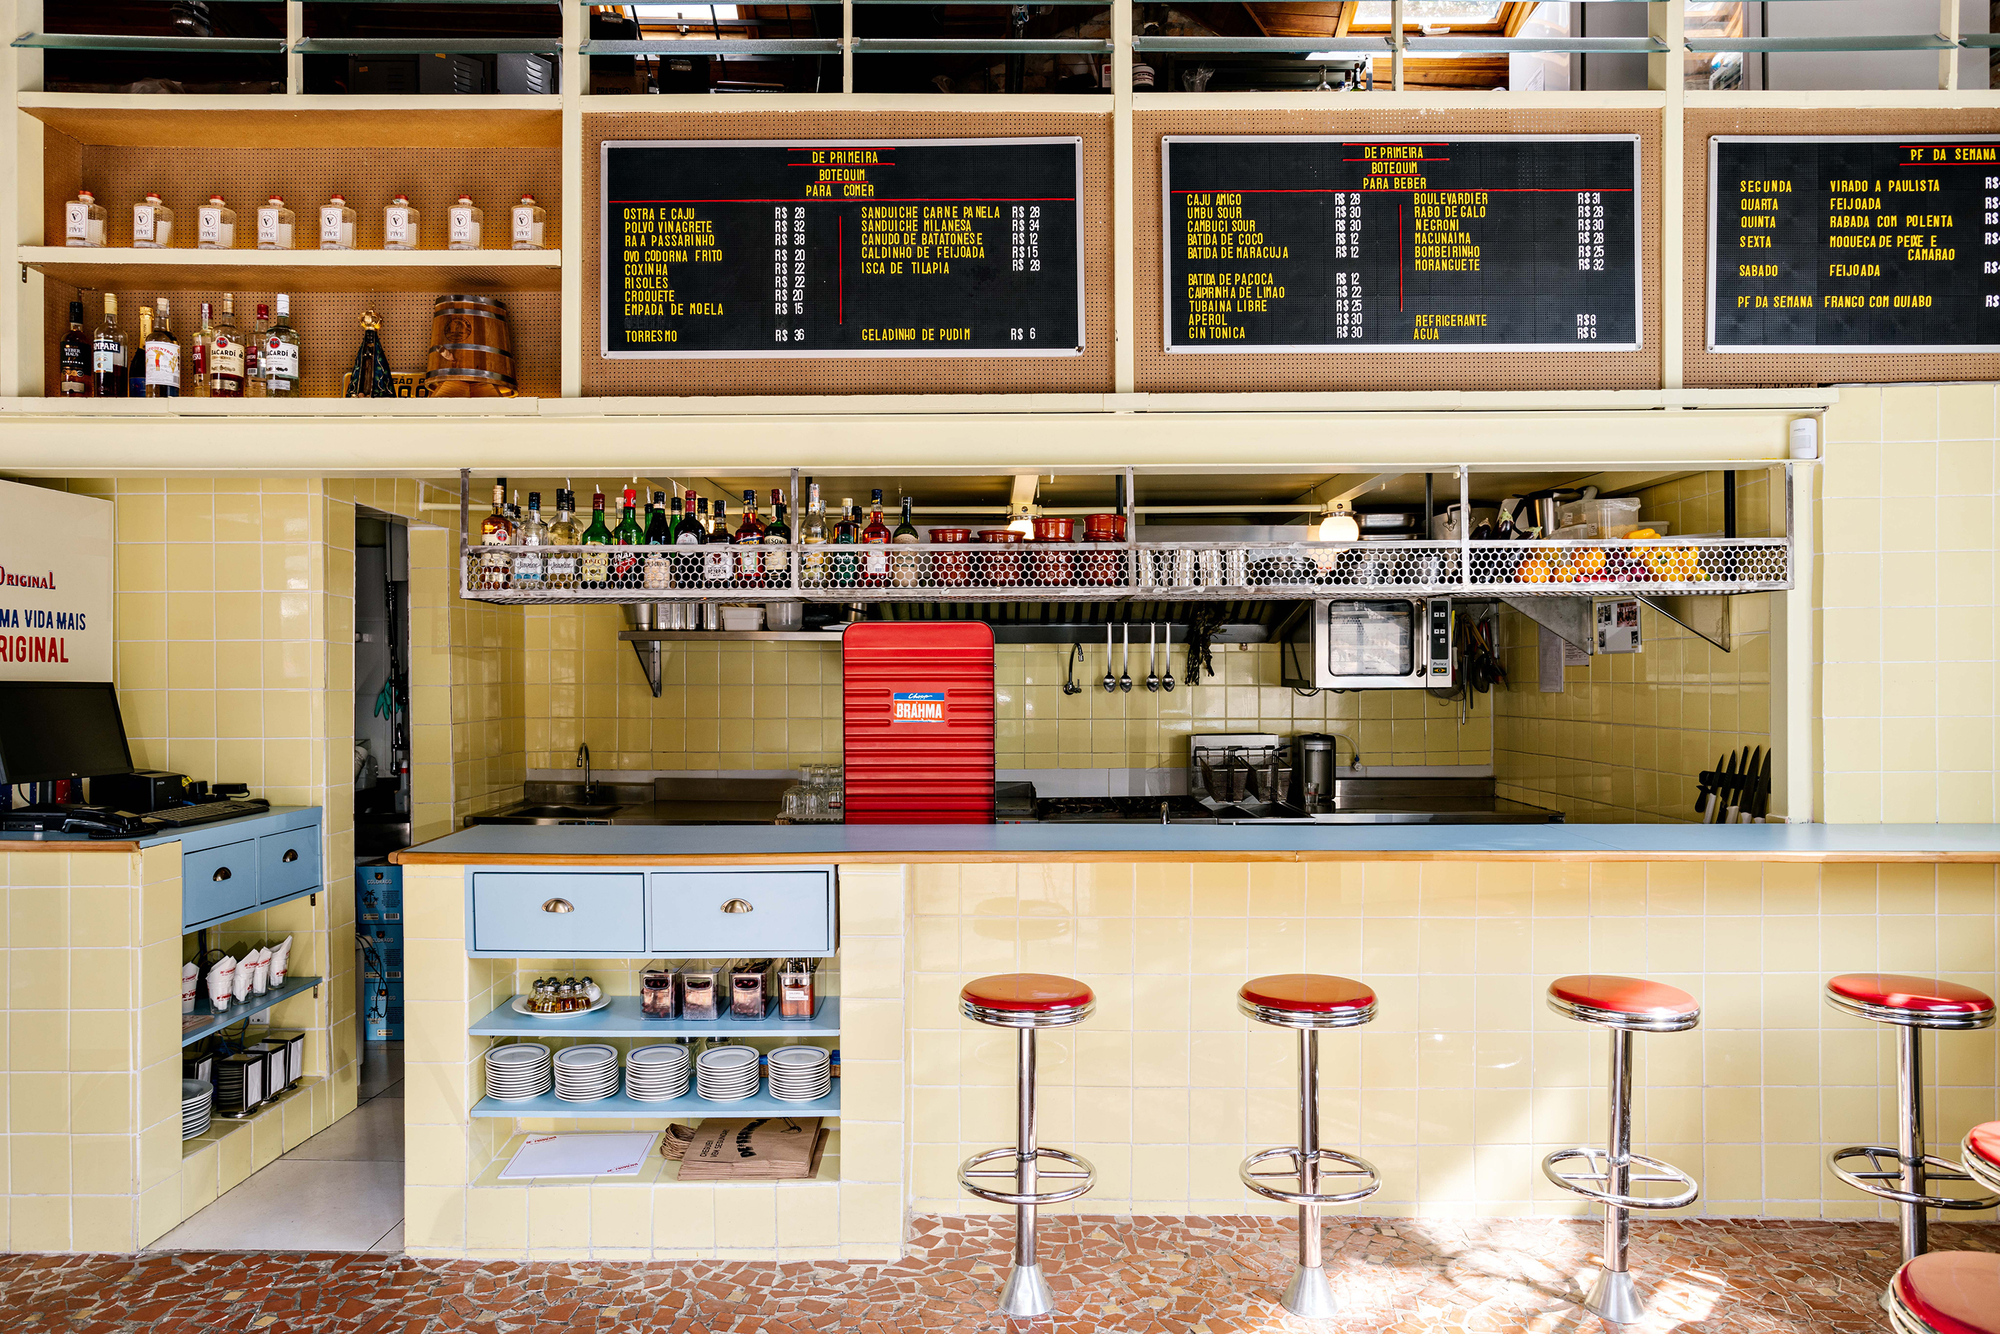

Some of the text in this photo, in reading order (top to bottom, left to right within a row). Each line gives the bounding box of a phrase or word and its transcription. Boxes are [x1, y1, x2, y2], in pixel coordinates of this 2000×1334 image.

[813, 151, 877, 163] DE PRIMEIRA
[1365, 147, 1423, 158] DE PRIMEIRA
[1911, 149, 1995, 160] PF DA SEMANA
[1372, 162, 1417, 174] BOTEQUIM
[820, 169, 864, 181] BOTEQUIM
[1363, 177, 1426, 189] PARA BEBER
[1741, 180, 1939, 192] SEGUNDA VIRADO A PAULISTA
[806, 184, 873, 196] PARA COMER
[1187, 194, 1241, 206] CAJU AMIGO
[1350, 193, 1360, 205] 28
[1414, 193, 1487, 204] BOULEVARDIER
[1741, 198, 1881, 210] QUARTA FEIJOADA
[624, 208, 694, 220] OSTRA E CAJU
[795, 207, 805, 218] 28
[862, 206, 999, 218] SANDUICHE CARNE PANELA
[1030, 206, 1040, 218] 28
[1188, 207, 1241, 219] UMBU SOUR
[1350, 206, 1361, 218] 30
[1415, 206, 1485, 217] RABO DE GALO
[1593, 206, 1603, 217] 28
[625, 221, 712, 233] POLVO VINAGRETE
[794, 220, 805, 232] 32
[862, 219, 971, 231] SANDUICHE MILANESA
[1029, 219, 1039, 231] 34
[1188, 220, 1255, 232] CAMBUCI SOUR
[1416, 219, 1458, 231] NEGRONI
[1741, 215, 1952, 228] QUINTA RABADA COM POLENTA
[625, 234, 714, 246] RA A PASSARINHO
[794, 234, 805, 245] 38
[862, 233, 982, 245] CANUDO DE BATATONESE
[1030, 233, 1038, 244] 12
[1188, 233, 1263, 245] BATIDA DE COCO
[1415, 232, 1470, 244] MACUNAIMA
[1740, 235, 1937, 248] SEXTA MOQUECA DE PEIXE E
[624, 250, 722, 262] OVO CODORNA FRITO
[795, 249, 805, 261] 20
[862, 246, 984, 258] CALDINHO DE FEIJOADA
[1028, 246, 1038, 258] 15
[1188, 247, 1288, 259] BATIDA DE MARACUJA
[1415, 246, 1480, 257] BOMBEIRINHO
[1594, 245, 1604, 257] 25
[1908, 249, 1955, 260] CAMARAO
[625, 263, 667, 275] COXINHA
[795, 262, 805, 274] 22
[862, 262, 949, 274] ISCA DE TILAPIA
[1030, 259, 1040, 271] 28
[1415, 259, 1480, 271] MORANGUETE
[1740, 264, 1880, 276] SABADO FEIJOADA
[625, 277, 668, 289] RISOLES
[795, 276, 805, 287] 22
[1189, 274, 1215, 285] BATIDA
[1220, 273, 1231, 285] DE
[625, 290, 674, 302] CROQUETE
[793, 289, 803, 301] 20
[1189, 287, 1284, 298] CAIPIRINHA DE LIMAO
[1191, 300, 1267, 312] TUBAINA LIBRE
[1738, 295, 1931, 308] PF DA SEMANA FRANGO COM QUIABO
[625, 303, 723, 315] EMPADA DE MOELA
[795, 303, 803, 314] 15
[1189, 314, 1227, 325] APEROL
[1416, 314, 1487, 326] REFRIGERANTE
[626, 330, 677, 342] TORRESMO
[794, 329, 804, 341] 36
[862, 328, 970, 340] GELADINHO DE PUDIM
[1030, 328, 1035, 339] 6
[1189, 327, 1245, 338] GIN TONICA
[1414, 328, 1439, 340] AGUA
[24, 609, 54, 629] VIDA
[56, 611, 87, 631] MAIS
[896, 702, 943, 719] BRAHMA
